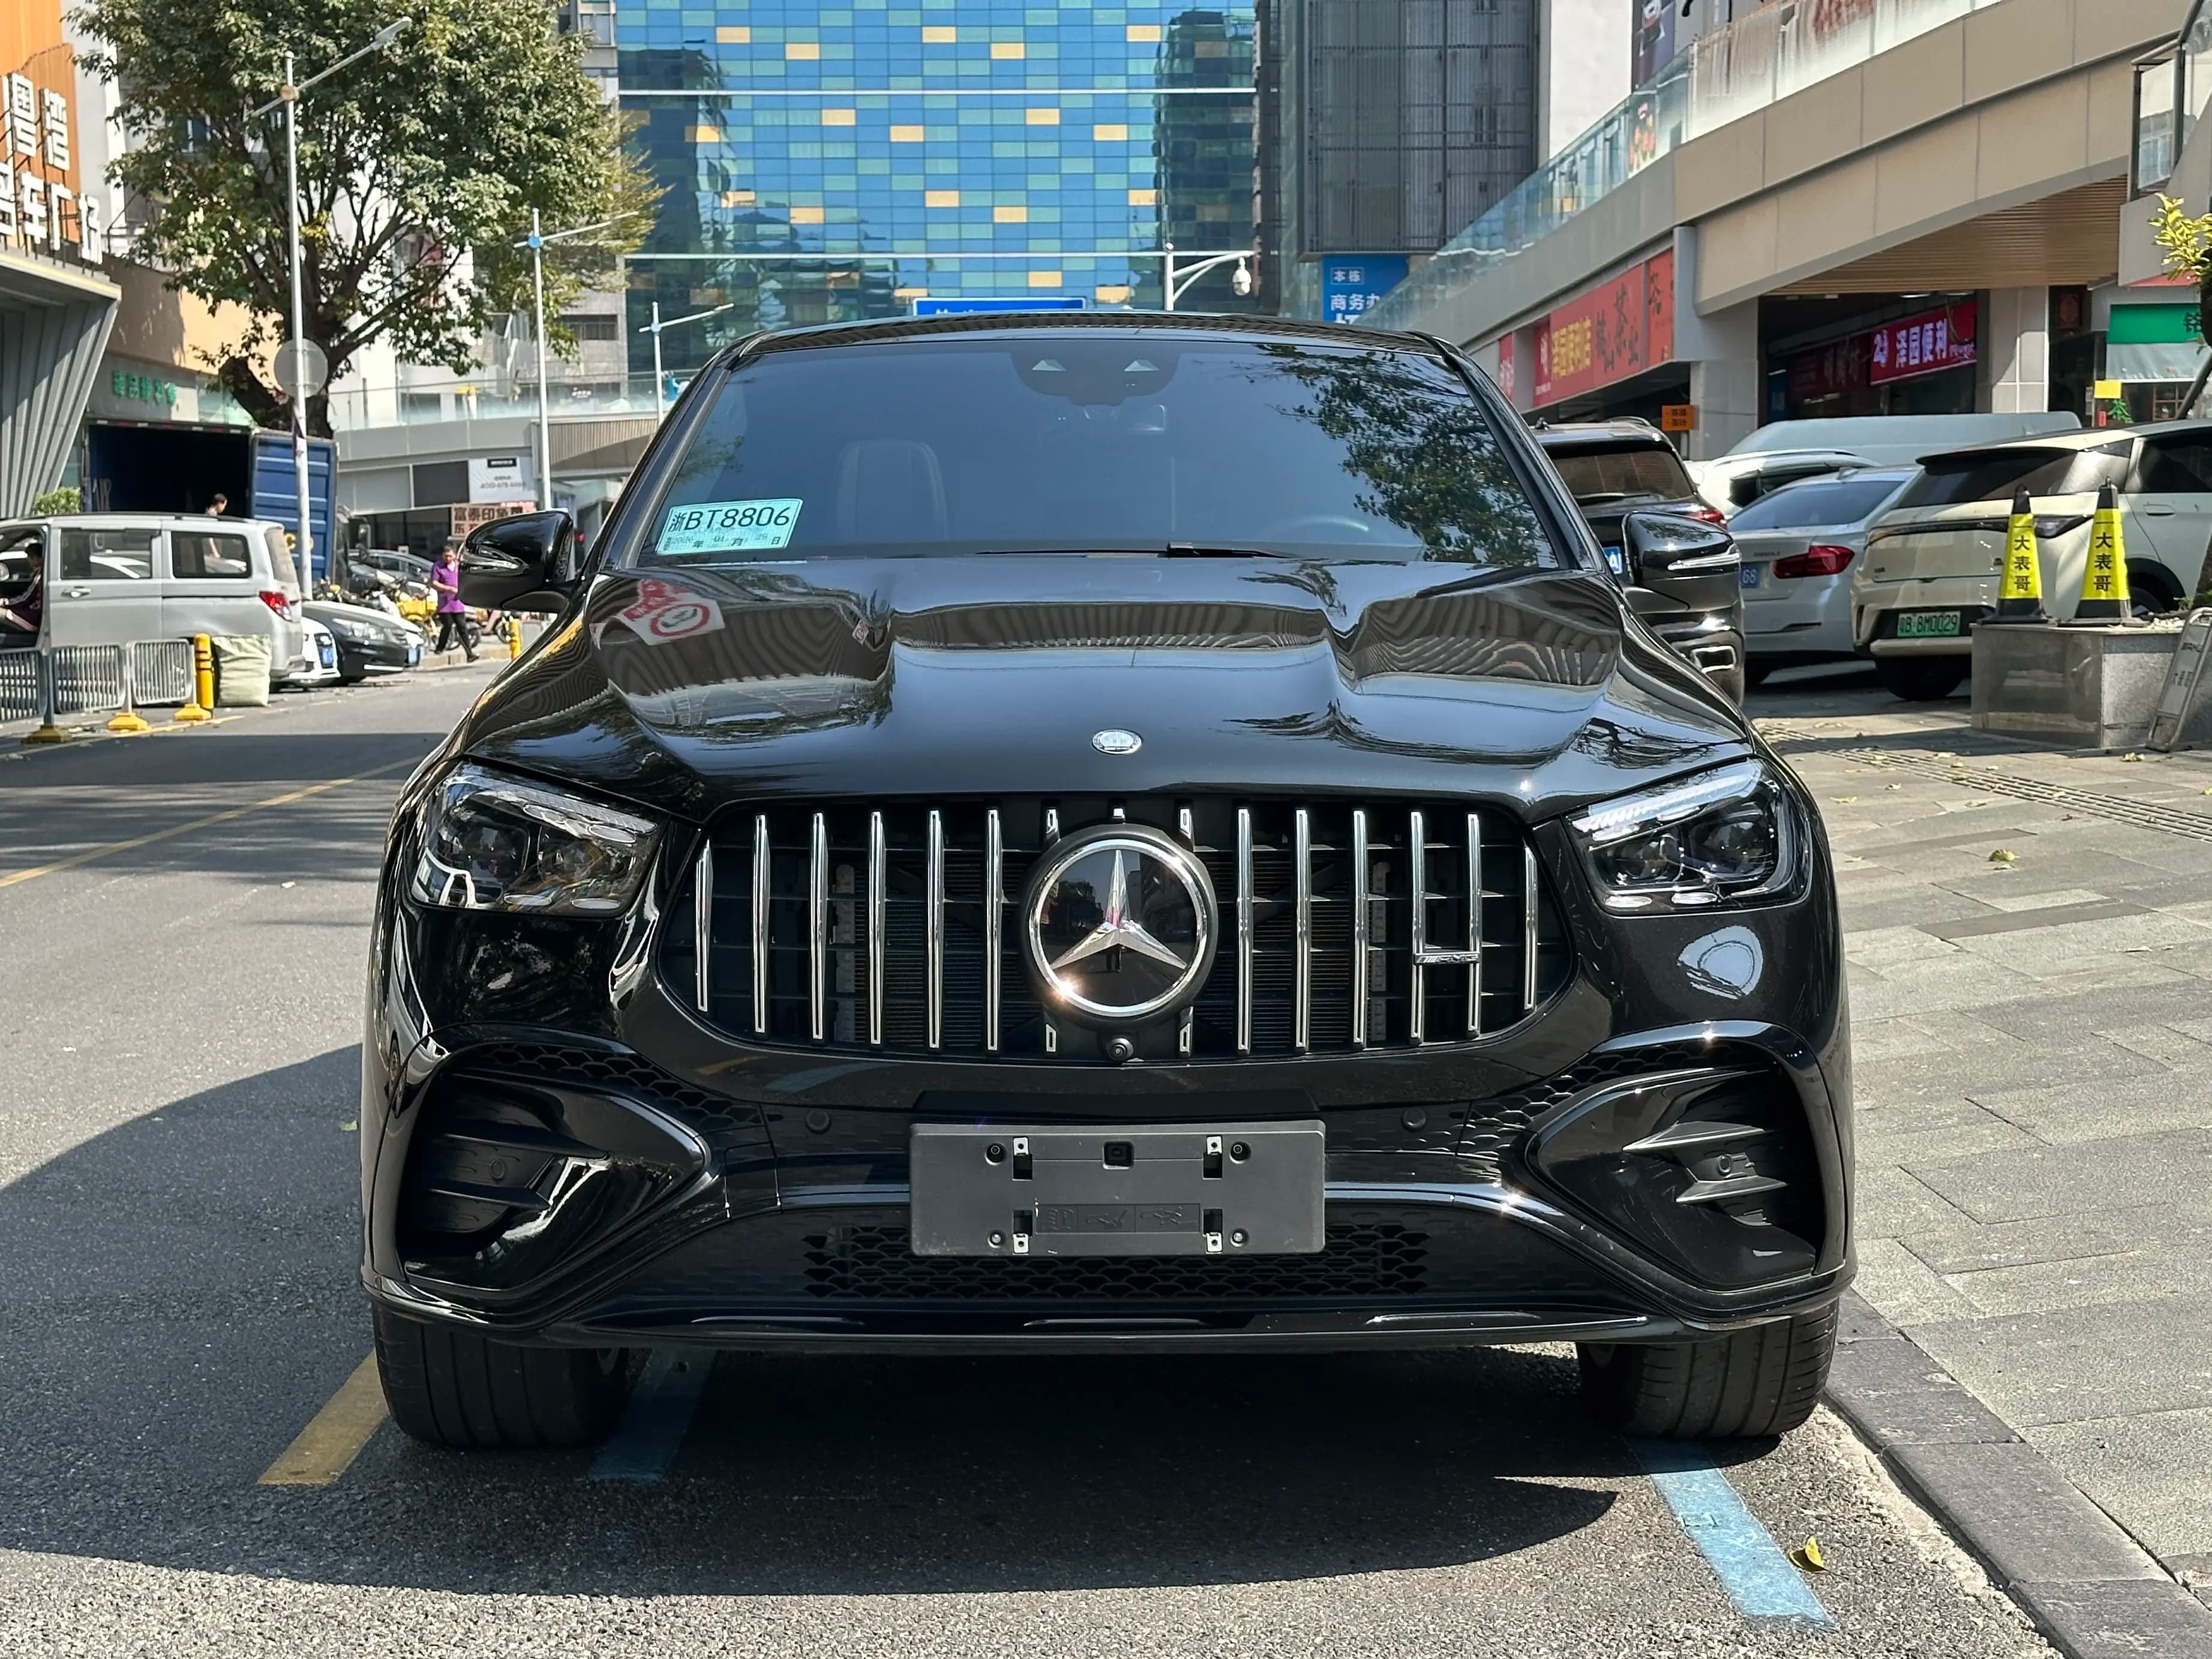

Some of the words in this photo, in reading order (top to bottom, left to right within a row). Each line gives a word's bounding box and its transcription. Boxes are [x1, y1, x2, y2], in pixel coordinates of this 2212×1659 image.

[2, 72, 70, 172] 粤港
[668, 507, 790, 532] 浙BT8806
[2014, 535, 2031, 591] 大表哥
[2093, 532, 2112, 592] 大表哥
